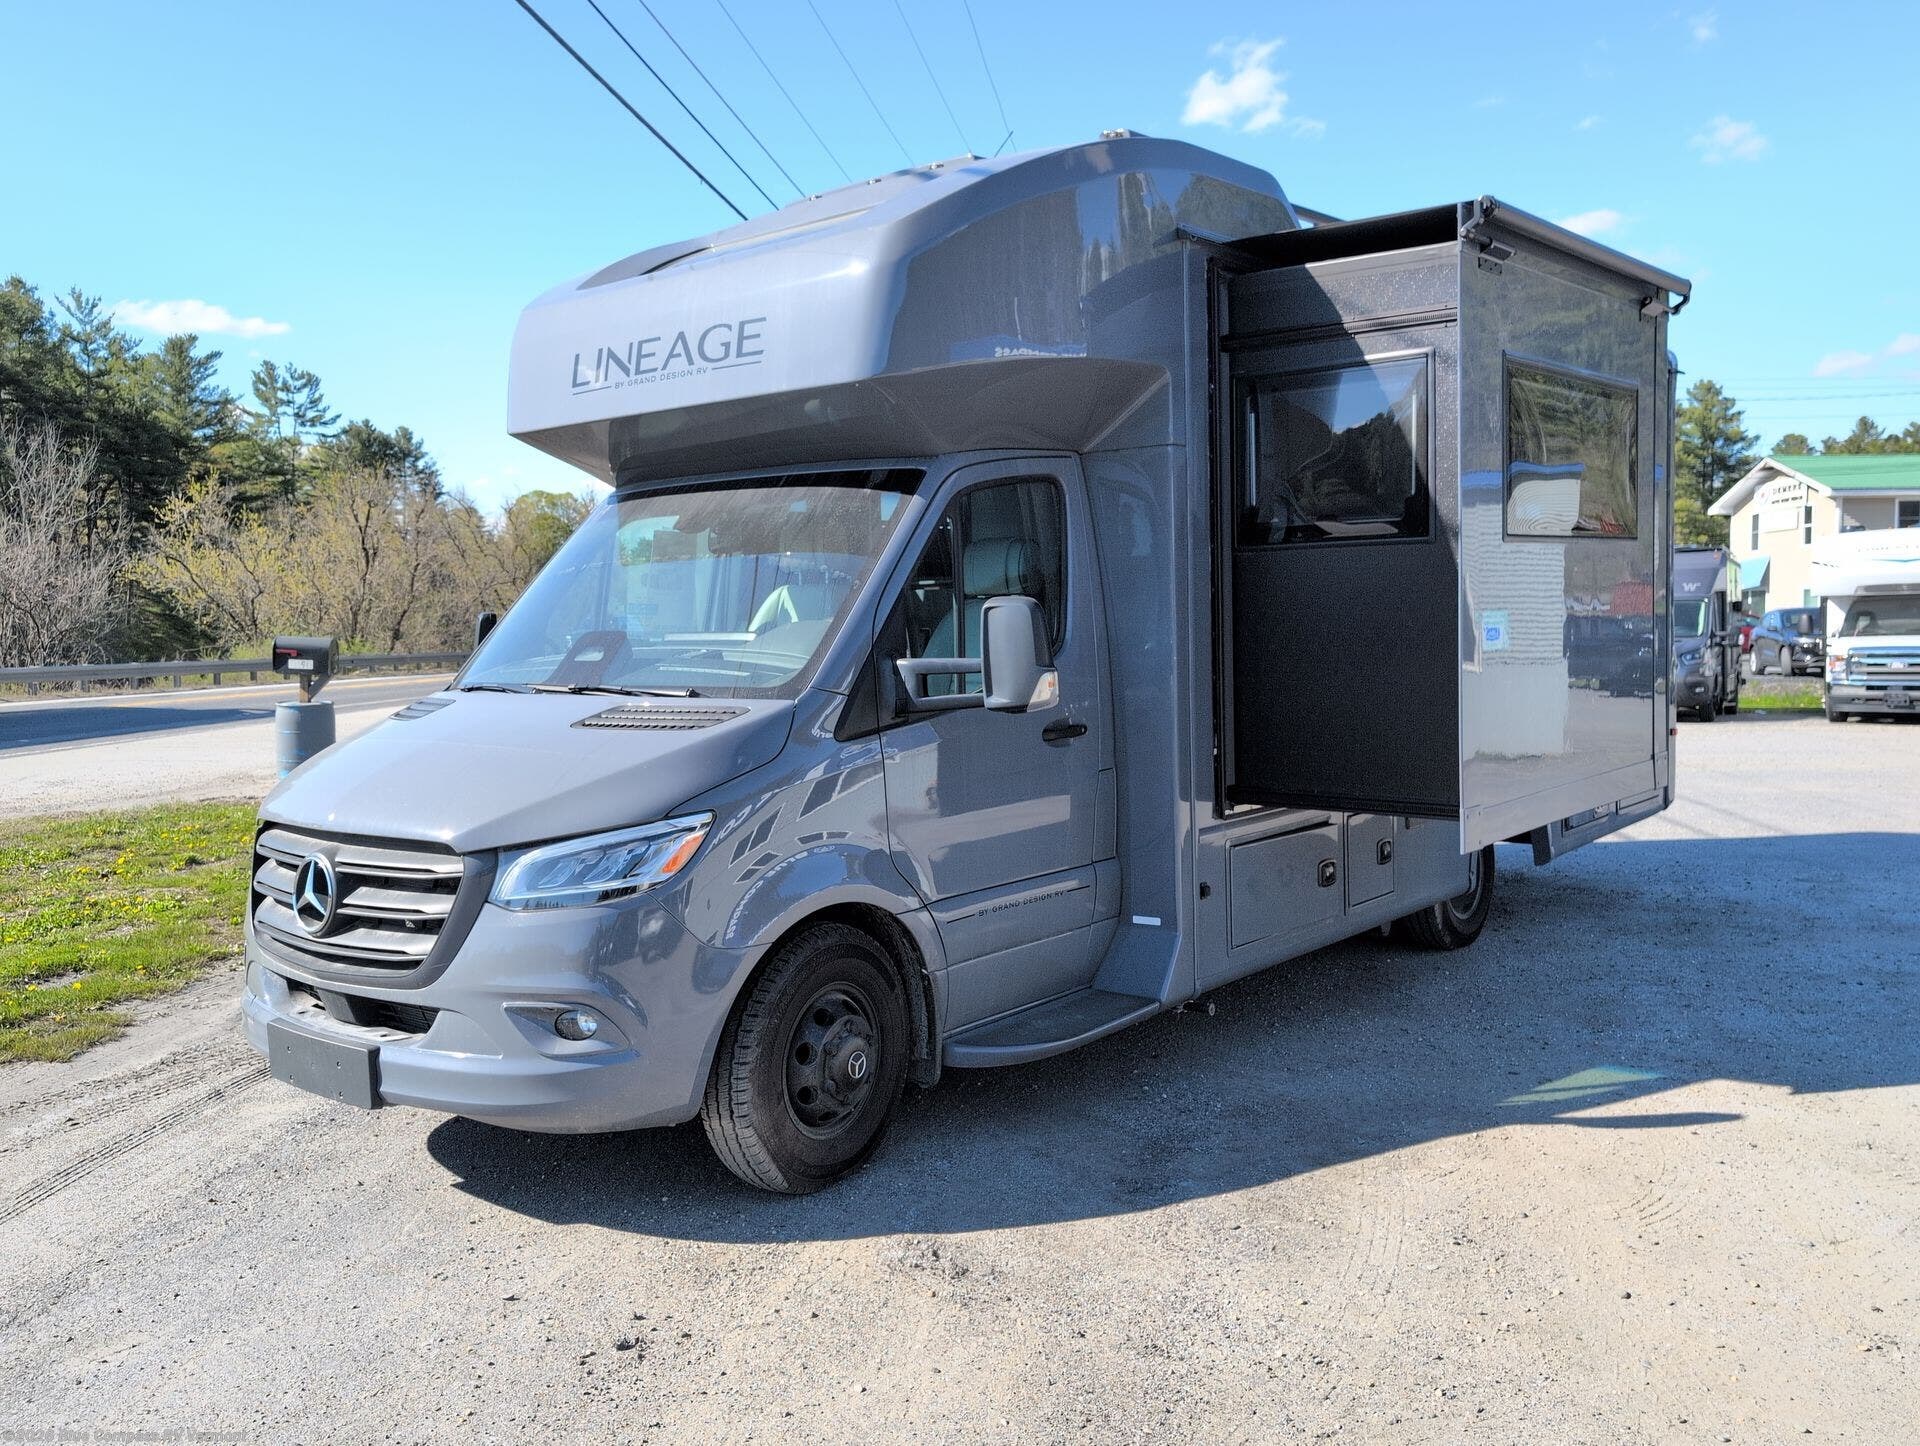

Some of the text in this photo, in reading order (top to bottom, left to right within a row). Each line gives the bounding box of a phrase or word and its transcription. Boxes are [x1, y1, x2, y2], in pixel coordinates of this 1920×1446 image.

[571, 317, 767, 388] LINEAGE
[614, 366, 709, 390] BY GRAND DESIGN RV
[978, 889, 1065, 917] BY GRAND DESIGN RV
